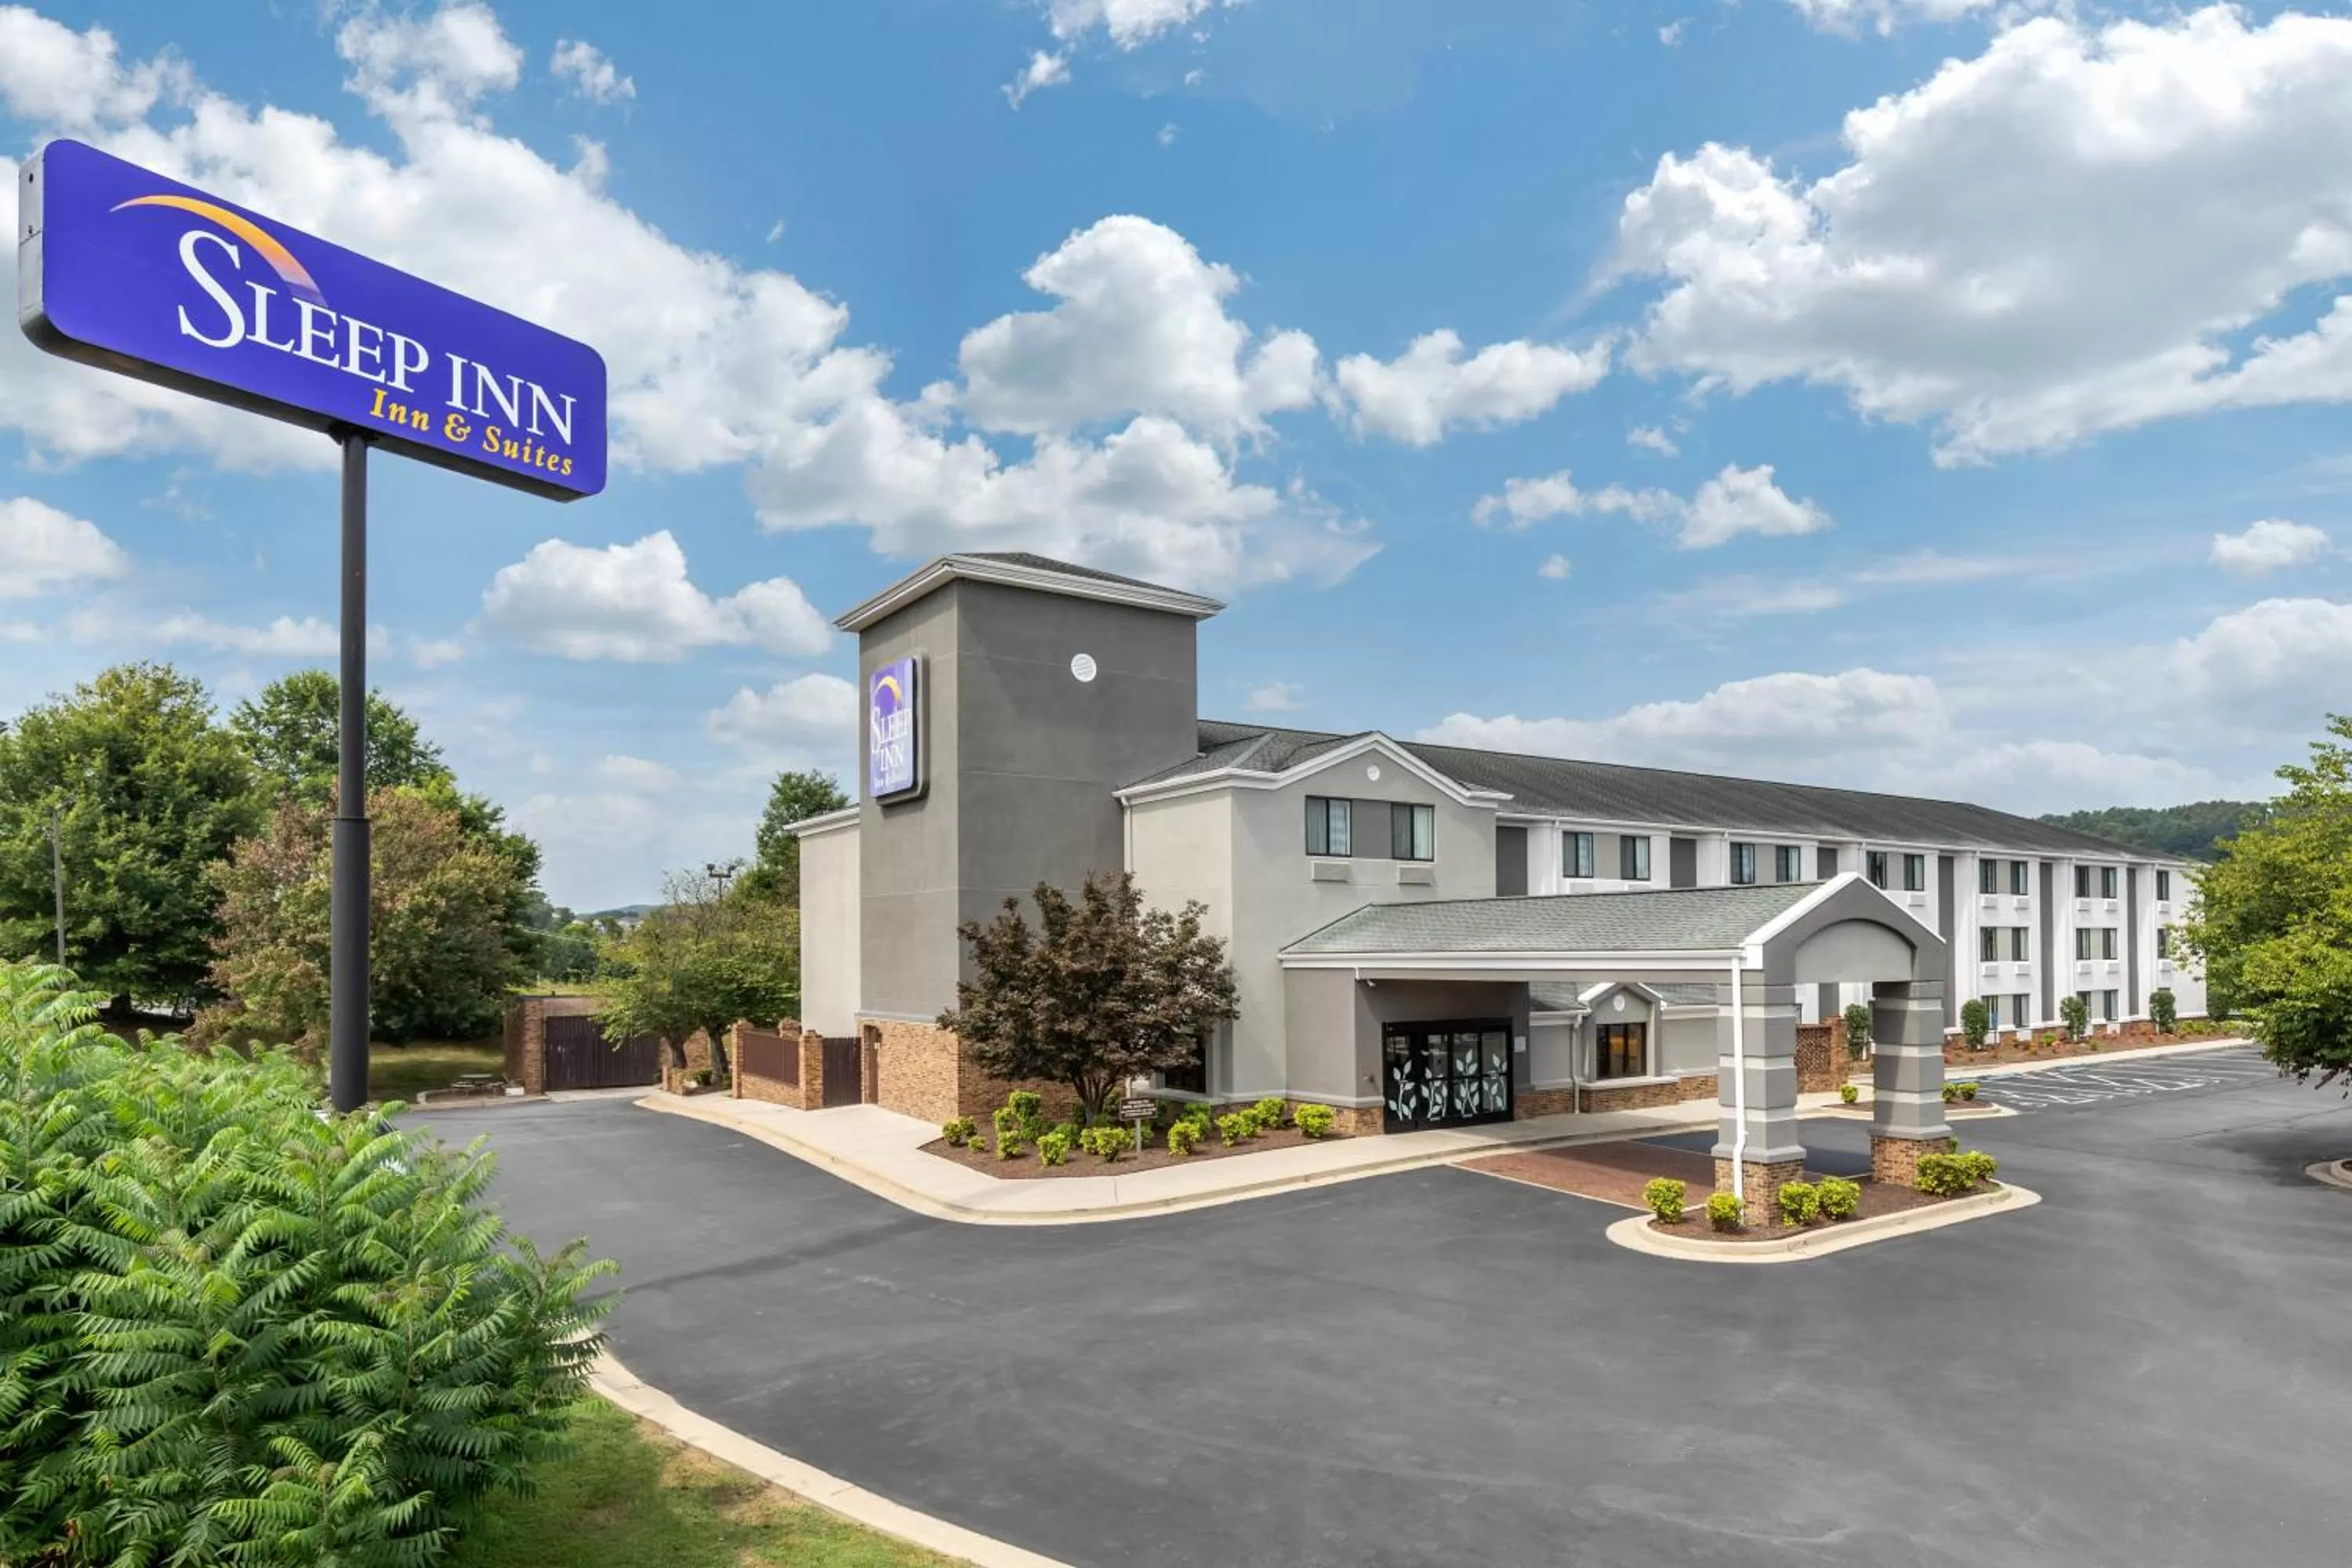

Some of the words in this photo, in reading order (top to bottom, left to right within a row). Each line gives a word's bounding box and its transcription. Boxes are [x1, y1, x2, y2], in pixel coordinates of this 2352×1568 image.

[178, 230, 430, 392] SLEEP
[445, 352, 577, 445] INN
[370, 388, 430, 431] Inn
[444, 413, 471, 442] &
[482, 426, 573, 475] Suites
[879, 744, 904, 771] INN
